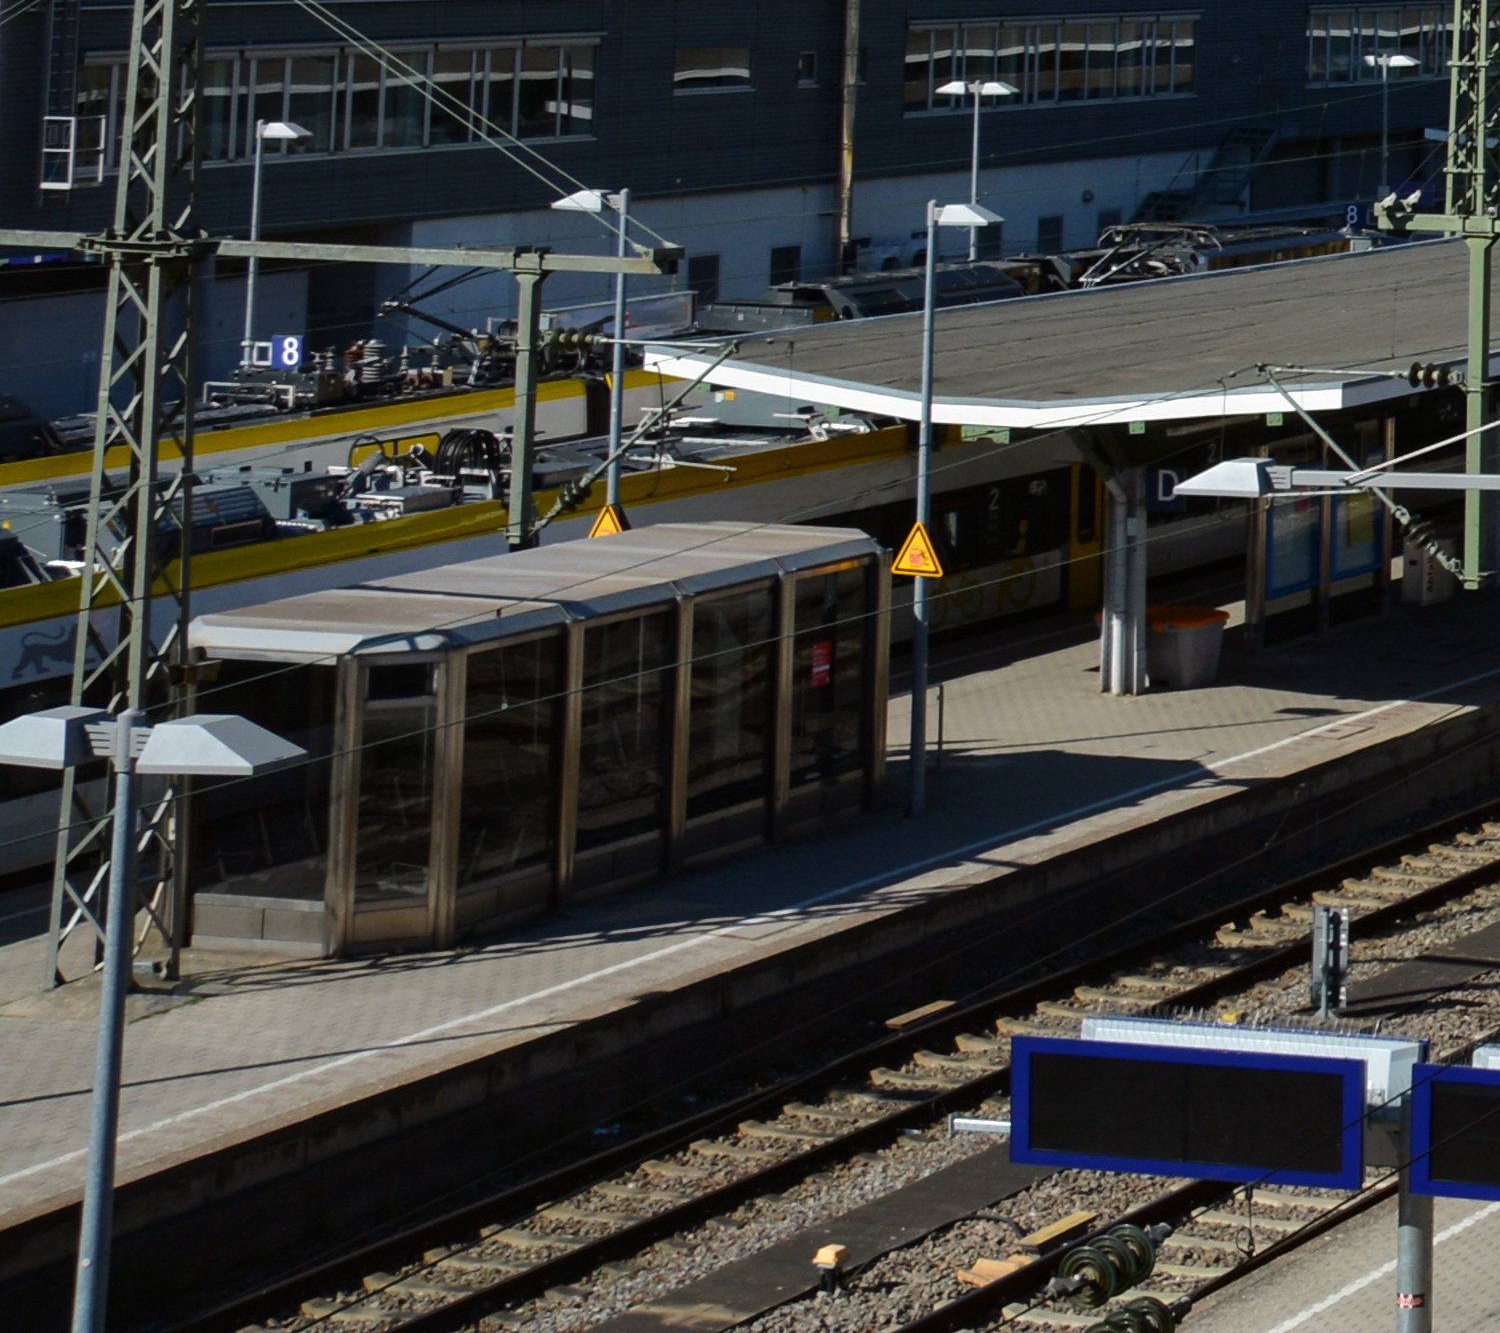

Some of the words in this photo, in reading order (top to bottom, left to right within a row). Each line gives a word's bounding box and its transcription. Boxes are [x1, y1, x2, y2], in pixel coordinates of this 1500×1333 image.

[1346, 205, 1358, 224] 8
[282, 337, 299, 366] 8
[1157, 468, 1181, 502] D
[988, 488, 999, 510] 2
